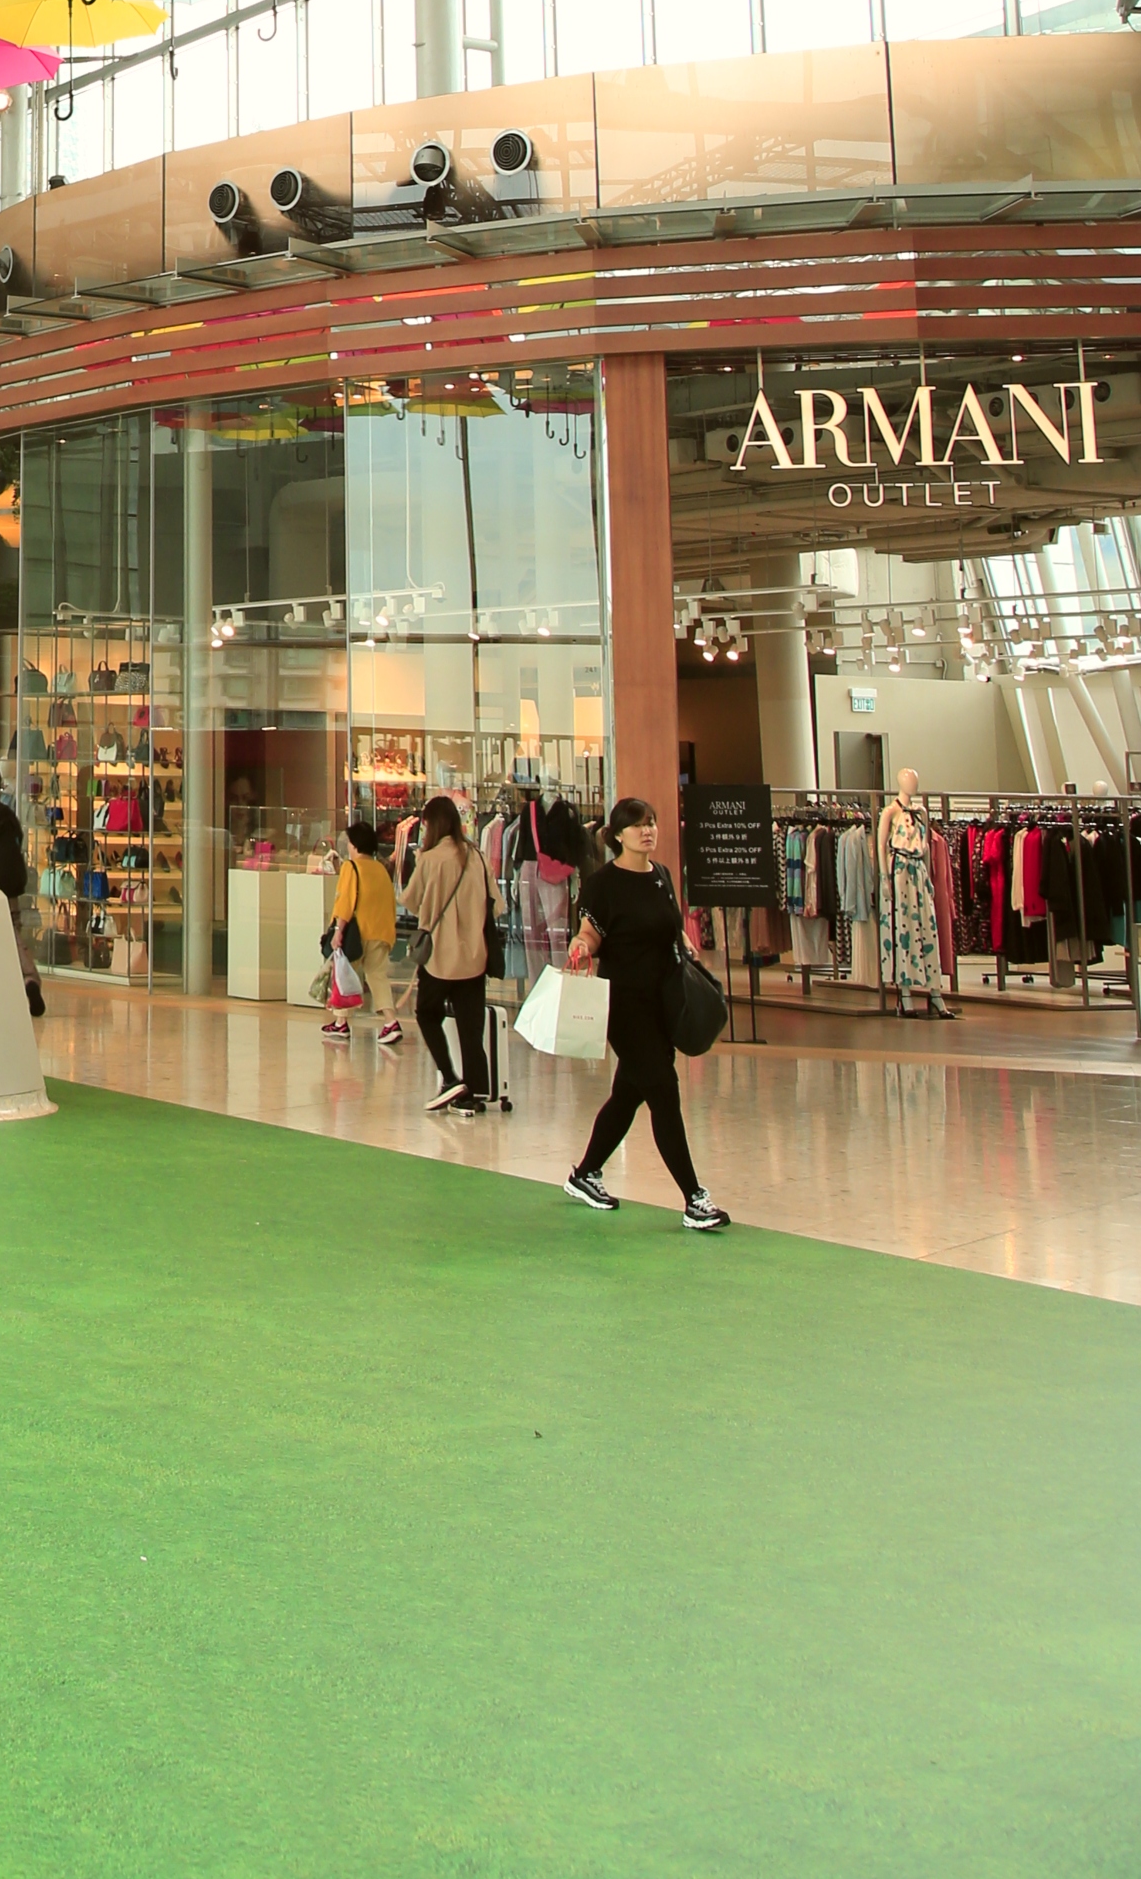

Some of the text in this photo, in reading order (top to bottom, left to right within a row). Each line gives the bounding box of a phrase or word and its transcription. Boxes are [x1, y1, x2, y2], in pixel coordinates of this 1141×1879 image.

[729, 382, 1105, 471] ARMANI
[828, 480, 1001, 508] OUTLET
[709, 801, 746, 810] ARMANI
